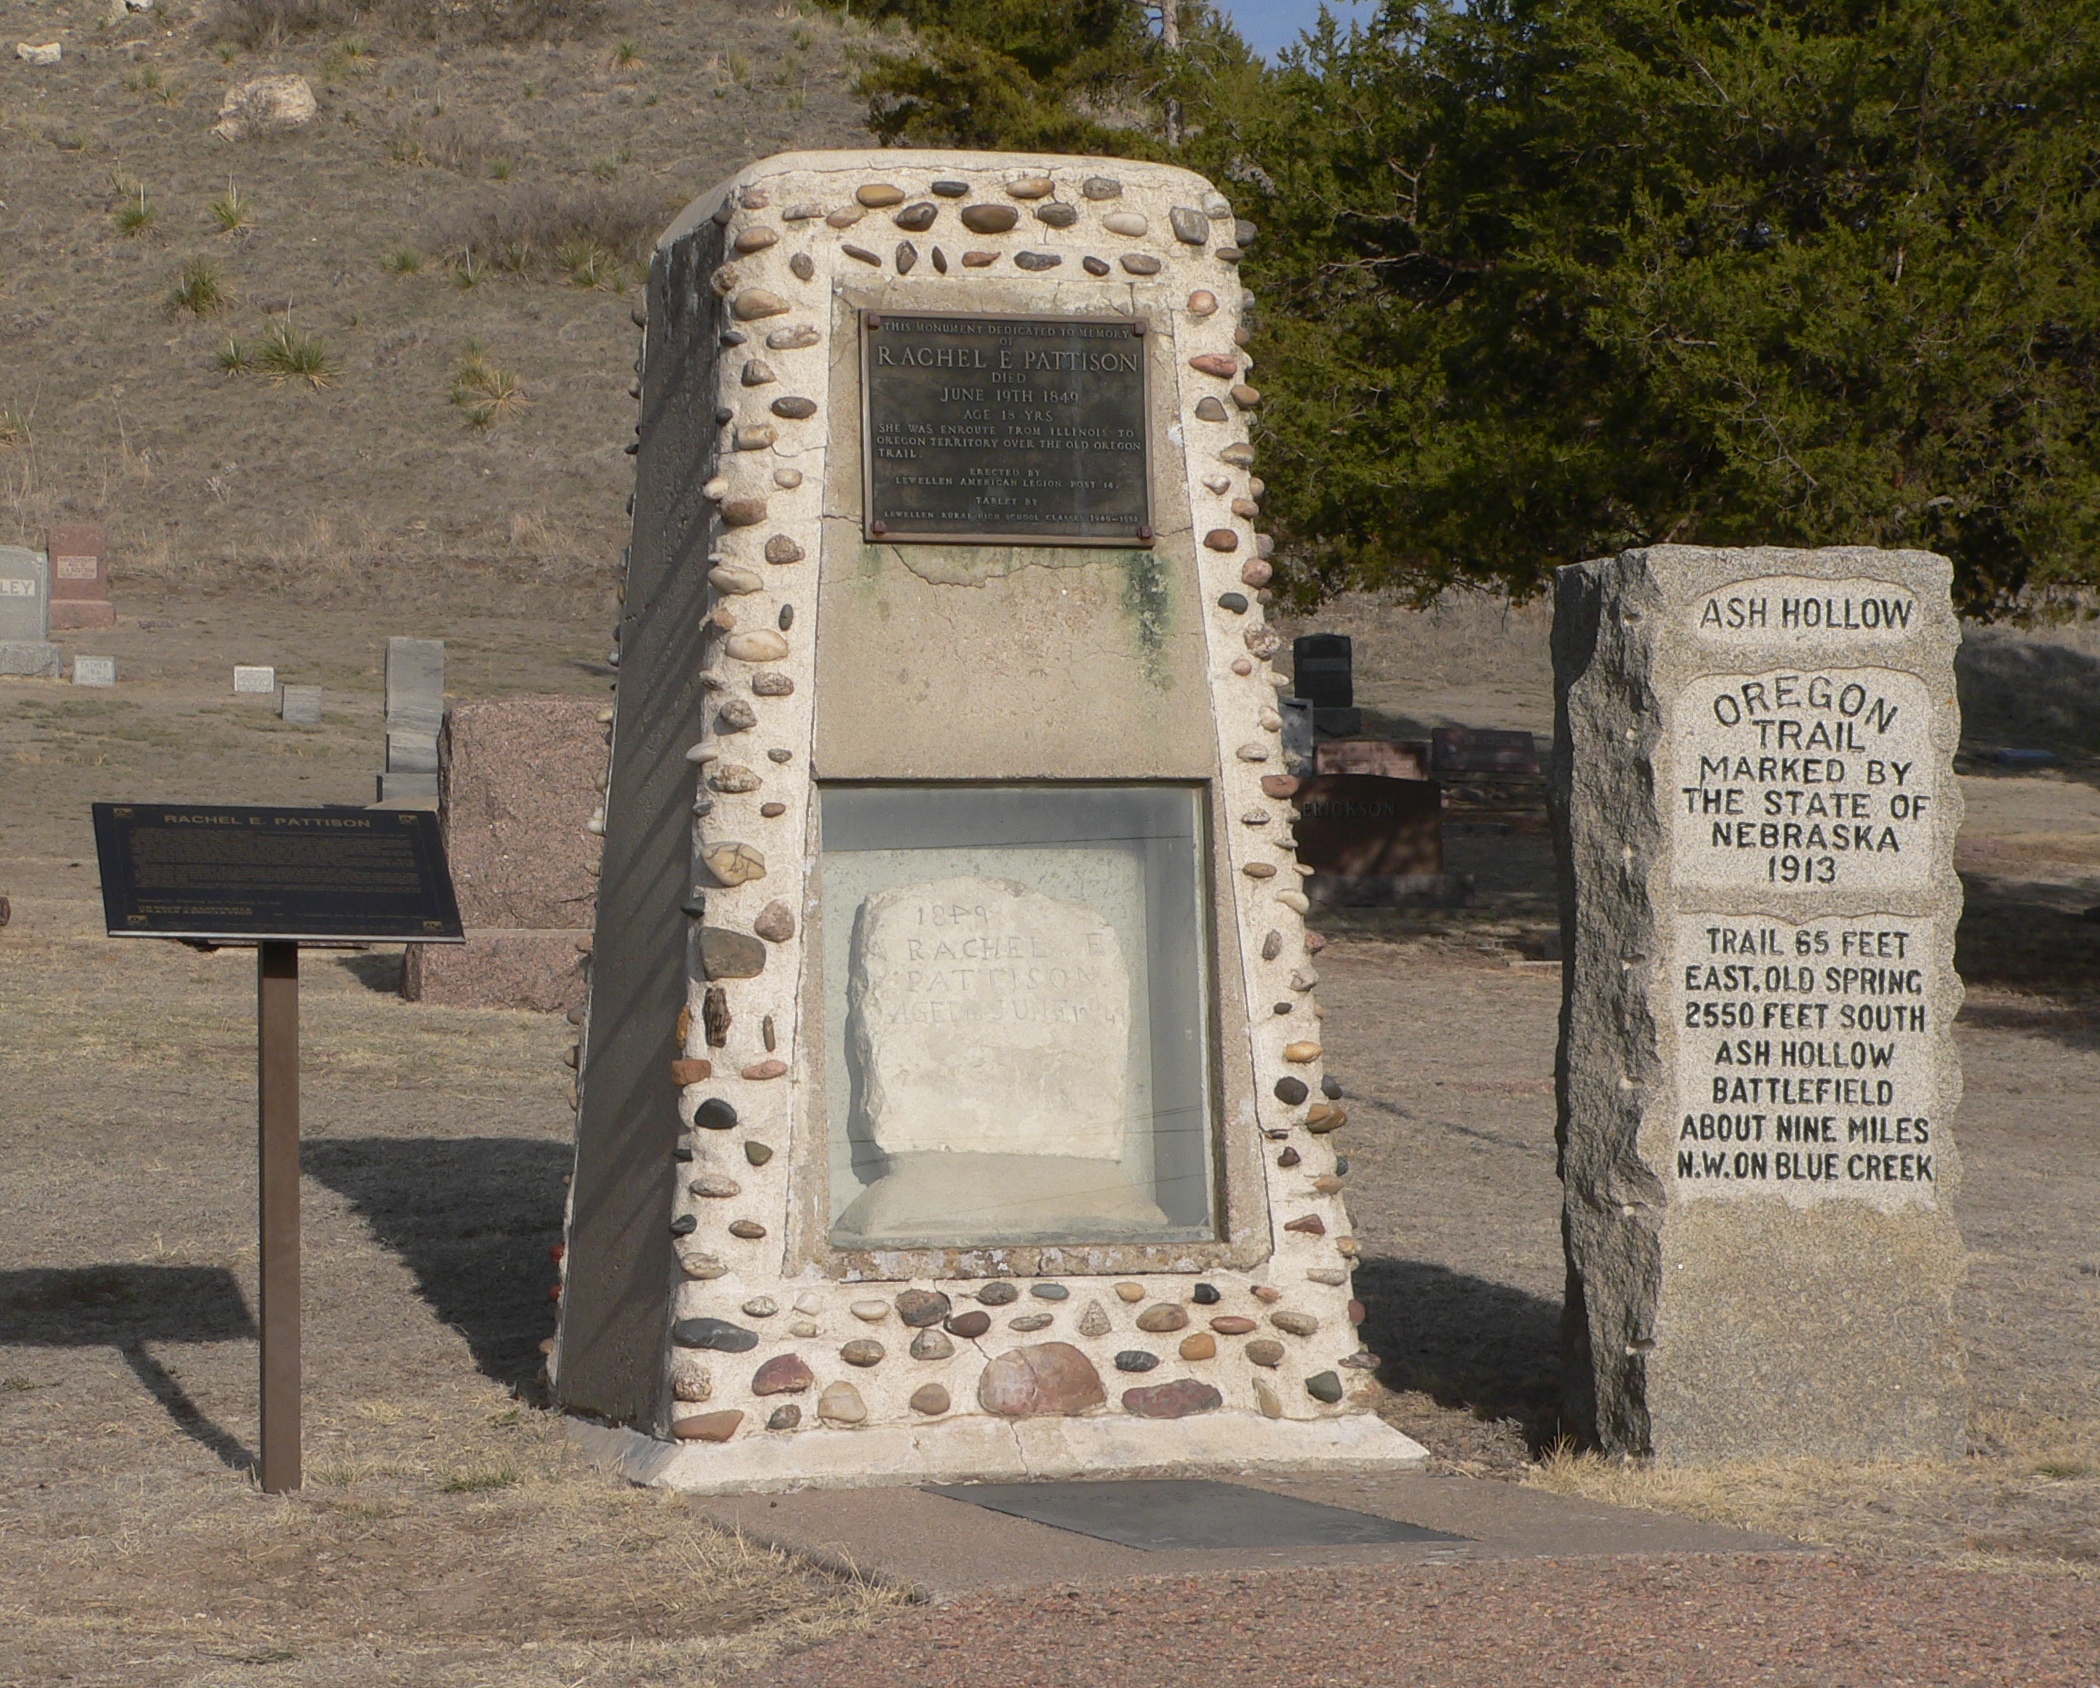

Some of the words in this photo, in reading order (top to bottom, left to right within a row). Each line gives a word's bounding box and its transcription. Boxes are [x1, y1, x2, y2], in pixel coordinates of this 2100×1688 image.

[884, 322, 911, 332] THIS
[916, 323, 983, 334] MONUMENT
[988, 325, 1056, 336] DEDICATED
[1060, 328, 1075, 337] TO
[1079, 328, 1131, 339] MEMORY
[999, 337, 1014, 346] OF
[878, 345, 987, 369] RACHEL
[1000, 350, 1013, 369] E
[1024, 349, 1138, 373] PATTISON
[991, 372, 1026, 383] DIED
[940, 387, 985, 403] JUNE
[996, 389, 1033, 403] 19TH
[1043, 390, 1079, 404] 1849
[963, 409, 991, 420] AGE
[1001, 410, 1015, 420] 18
[1024, 410, 1053, 422] YRS
[876, 436, 926, 446] OREGON
[929, 437, 998, 448] TERRITORY
[1003, 439, 1035, 448] OVER
[1040, 439, 1061, 449] THE
[1066, 440, 1089, 450] OLD
[1093, 440, 1141, 450] OREGON
[878, 423, 901, 433] SHE
[908, 424, 933, 434] WAS
[941, 425, 996, 435] ENROUTE
[1008, 426, 1040, 436] FROM
[1050, 427, 1107, 437] ILLINOIS
[1118, 429, 1134, 438] TO
[878, 448, 923, 458] TRAIL.
[895, 476, 953, 485] LEWELLEN
[960, 478, 1018, 487] AMERICAN
[1023, 479, 1061, 488] LEGION
[1070, 481, 1096, 489] POST
[969, 468, 1019, 476] ERECTED
[1028, 469, 1040, 477] BY
[976, 496, 1017, 505] TABLET
[1025, 498, 1038, 506] BY
[884, 510, 934, 519] LEWELLEN
[1699, 597, 1767, 630] ASH
[1781, 597, 1913, 630] HOLLOW
[1713, 675, 1899, 734] OREGON
[1751, 719, 1866, 752] TRAIL
[1699, 755, 1846, 784] MARKED
[1866, 760, 1913, 786] BY
[1301, 801, 1397, 819] ERICKSON
[1682, 787, 1745, 815] THE
[1763, 789, 1872, 819] STATE
[1890, 794, 1932, 820] OF
[163, 814, 243, 826] RACHEL
[249, 816, 267, 826] E.
[273, 817, 372, 829] PATTISON
[1711, 821, 1901, 852] NEBRASKA
[1768, 855, 1837, 883] 1913
[916, 904, 989, 926] 1849
[907, 936, 1050, 961] RACHEL
[1705, 928, 1785, 956] TRAIL
[1795, 930, 1830, 957] 65
[1841, 931, 1910, 959] FEET
[906, 967, 1097, 992] PATTISON
[1825, 966, 1923, 996] SPRING
[1685, 1001, 1755, 1029] 2550
[1763, 1002, 1830, 1030] FEET
[1840, 1004, 1926, 1032] SOUTH
[1714, 1039, 1771, 1067] ASH
[1781, 1041, 1896, 1069] HOLLOW
[1712, 1076, 1894, 1106] BATTLEFIELD
[1679, 1113, 1767, 1142] ABOUT
[1776, 1114, 1838, 1143] NINE
[1848, 1115, 1930, 1144] MILES
[1775, 1152, 1841, 1181] BLUE
[1847, 1153, 1934, 1182] CREEK
